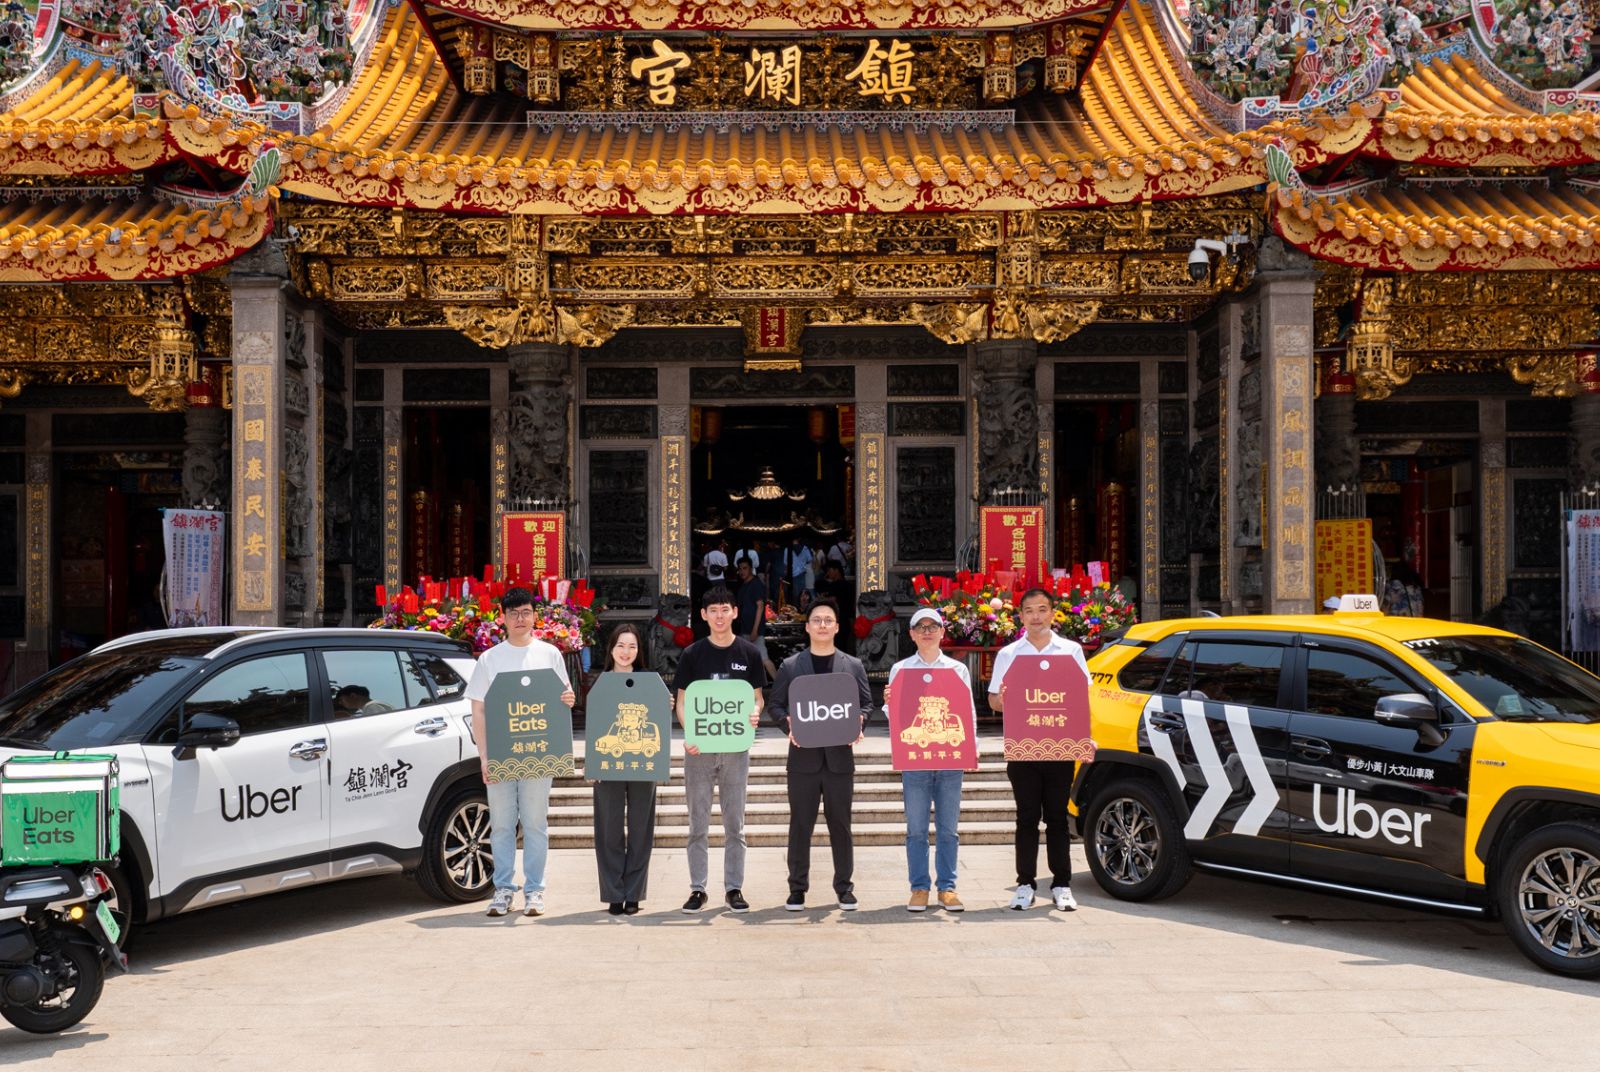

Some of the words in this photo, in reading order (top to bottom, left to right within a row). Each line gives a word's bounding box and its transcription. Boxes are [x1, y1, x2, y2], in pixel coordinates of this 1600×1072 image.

[631, 39, 917, 105] 鎮瀾宮
[1283, 409, 1306, 545] 風調雨順
[244, 419, 265, 556] 國泰民安
[170, 513, 221, 531] 鎮瀾宮
[524, 520, 556, 532] 歡迎
[1003, 514, 1036, 527] 歡迎
[1353, 598, 1372, 609] Uber
[731, 662, 747, 671] Uber
[1025, 688, 1066, 703] Uber
[508, 702, 546, 716] Uber
[694, 697, 744, 715] Uber
[796, 700, 852, 722] Uber
[509, 717, 548, 732] Eats
[694, 718, 745, 736] Eats
[343, 758, 413, 793] 鎮瀾宮
[1388, 764, 1434, 780] 大文山車隊
[219, 784, 302, 822] Uber
[23, 806, 75, 824] Uber
[1313, 783, 1432, 848] Uber
[23, 827, 75, 845] Eats
